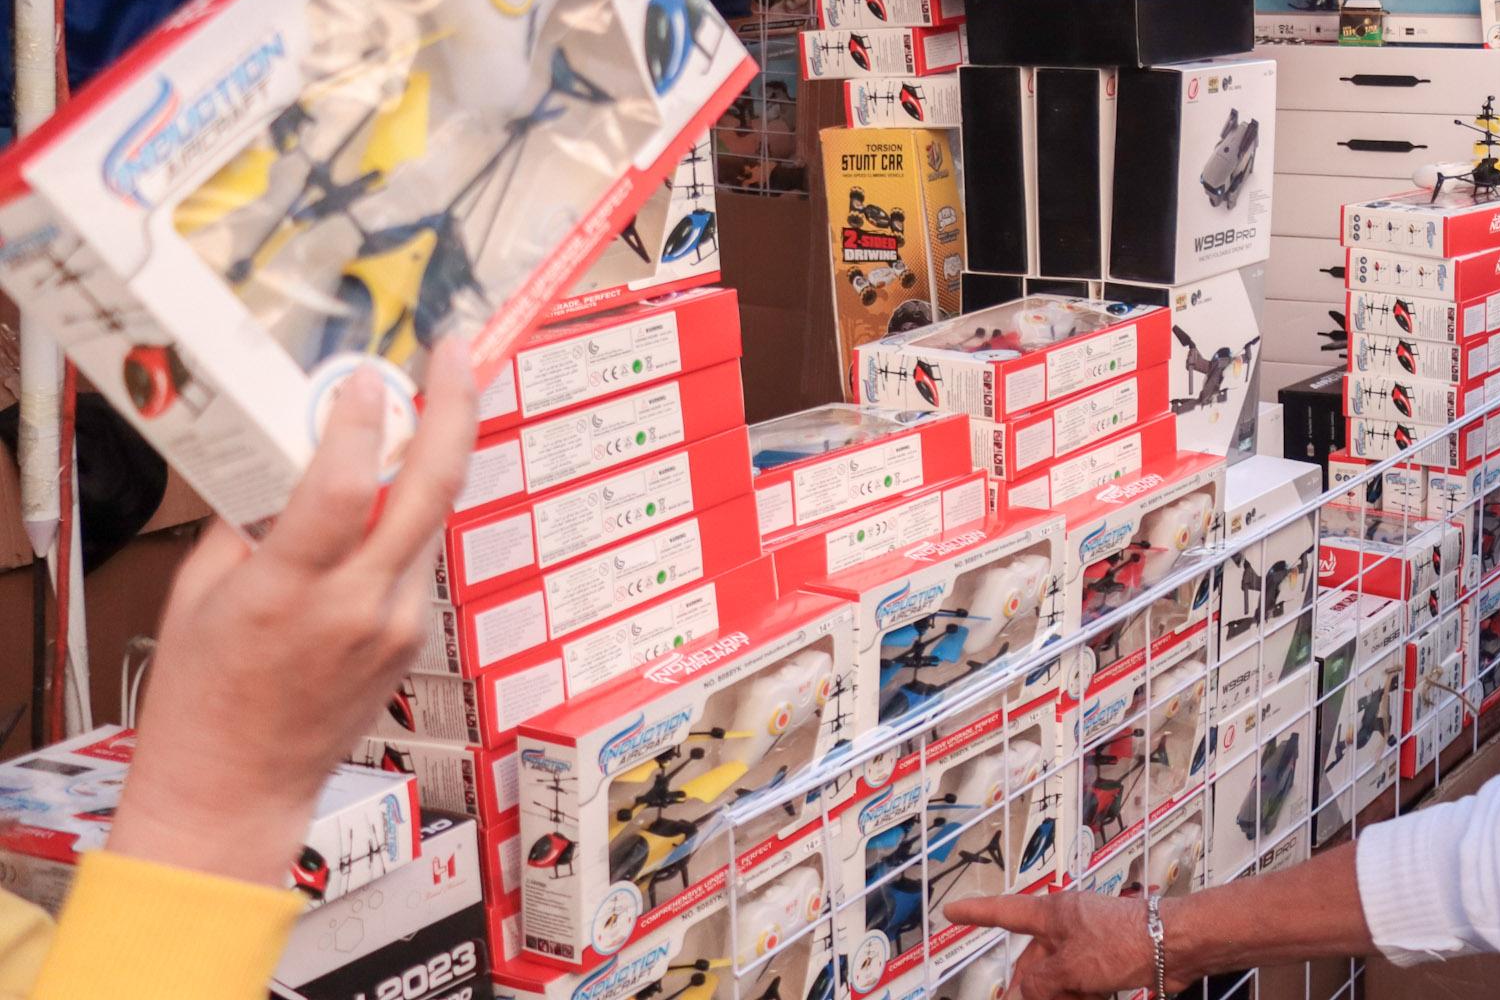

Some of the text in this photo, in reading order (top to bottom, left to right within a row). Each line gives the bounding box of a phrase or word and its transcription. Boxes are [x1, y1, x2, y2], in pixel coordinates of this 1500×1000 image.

[866, 144, 903, 152] TORSION
[842, 155, 903, 171] STUNT CAR
[1194, 227, 1257, 253] W998 PRO
[583, 289, 622, 306] PERFECT
[877, 582, 946, 620] INDUCTION
[890, 599, 935, 623] AIRCRAFT
[645, 631, 750, 683] INDUCTION
[703, 680, 716, 689] NO.
[602, 707, 693, 759] INDUCTION
[973, 713, 999, 734] PERFECT
[619, 732, 676, 766] AIRCRAFT
[874, 802, 920, 828] AIRCRAFT
[640, 842, 773, 928] COMPREHENSIVE PERFECT
[376, 941, 477, 1000] 2023
[574, 942, 671, 1000] INDUCTION
